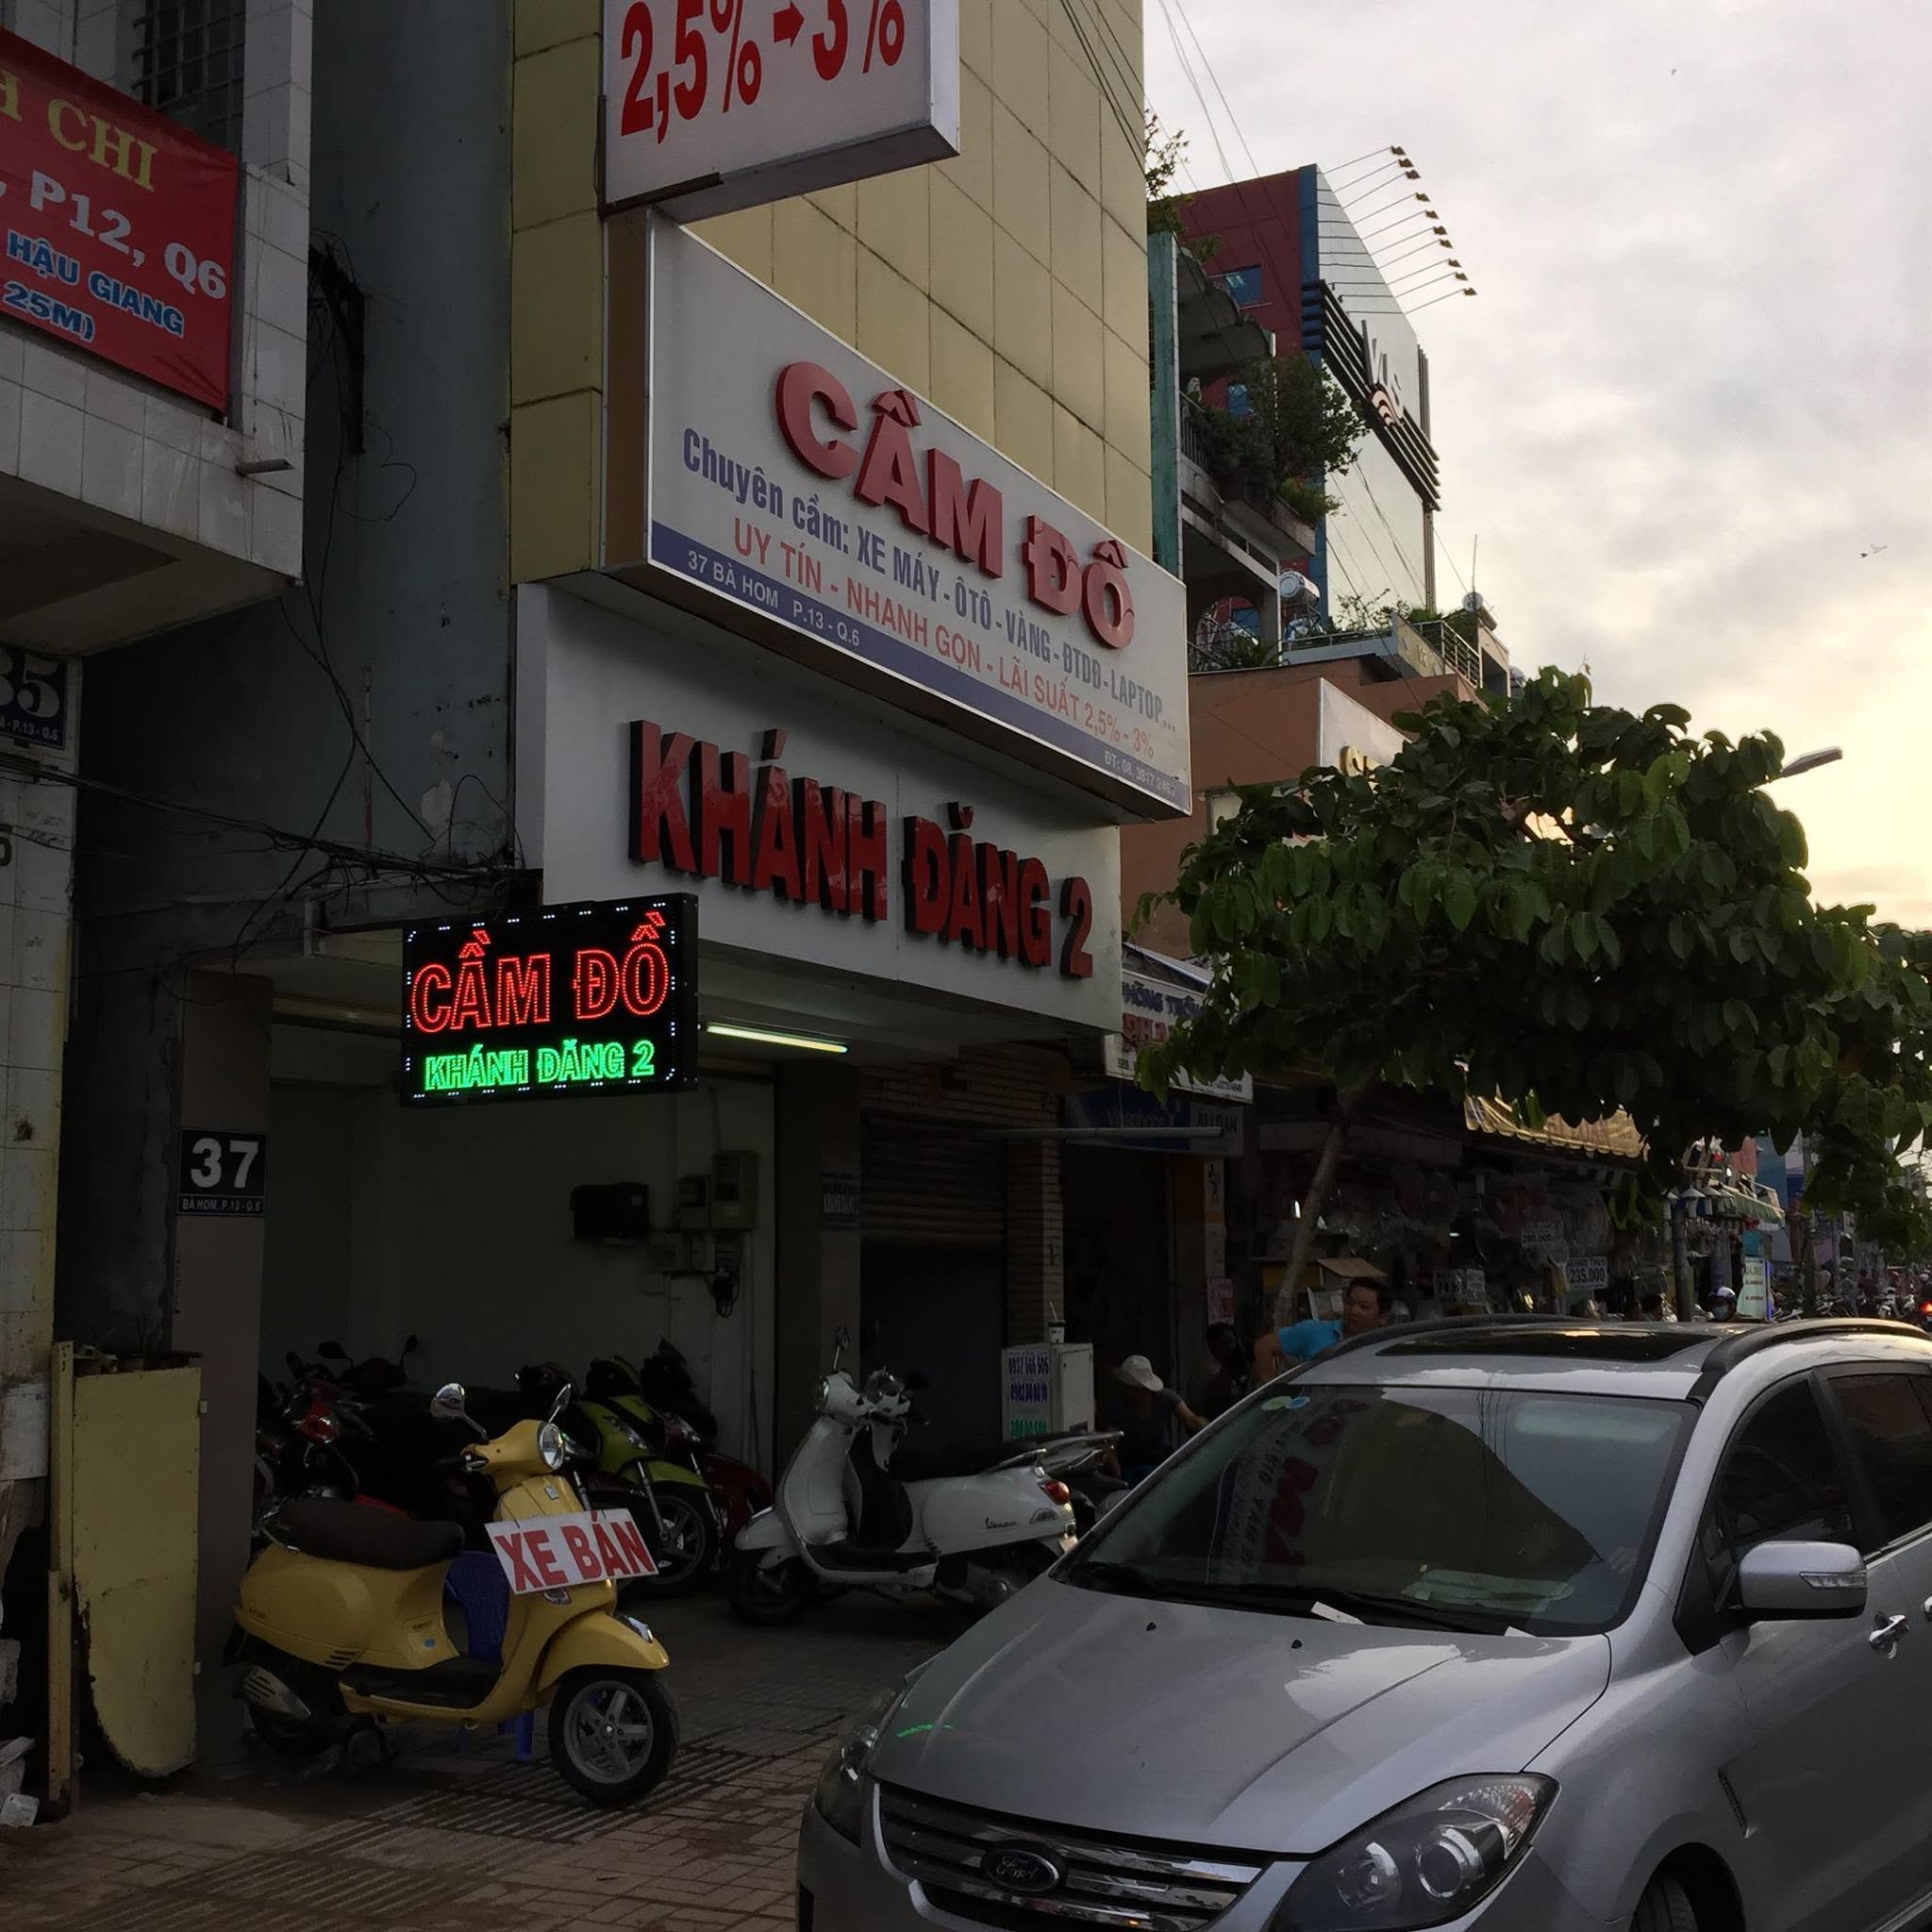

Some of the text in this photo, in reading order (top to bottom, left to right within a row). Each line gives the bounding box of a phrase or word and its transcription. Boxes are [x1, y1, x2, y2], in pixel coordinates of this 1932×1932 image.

[47, 97, 158, 192] CHI
[7, 229, 185, 339] HẬU GIANG
[29, 170, 227, 301] P12, Q6
[2, 282, 95, 343] 25M)
[684, 427, 783, 519] Chuyên
[792, 493, 848, 555] cầm:
[857, 525, 885, 575] XE
[893, 545, 939, 603] MÁY
[1006, 608, 1050, 663] VÀNG
[776, 361, 1136, 649] CẦM ĐỒ
[688, 549, 860, 647] 37 BÀ HOM P.13 Q.6
[734, 517, 771, 566] UY
[780, 541, 822, 594] TÍN
[847, 576, 928, 648] NHANH
[935, 625, 981, 674] GỌN
[1000, 656, 1028, 697] LÃI
[1034, 675, 1079, 722] SUẤT
[1133, 726, 1154, 758] 3%
[628, 720, 1093, 978] KHÁNH ĐĂNG 2
[411, 910, 670, 1034] CẦM ĐỒ
[425, 1039, 655, 1091] KHÁNH ĐĂNG 2
[191, 1138, 259, 1189] 37
[494, 1508, 656, 1591] XE BÁN
